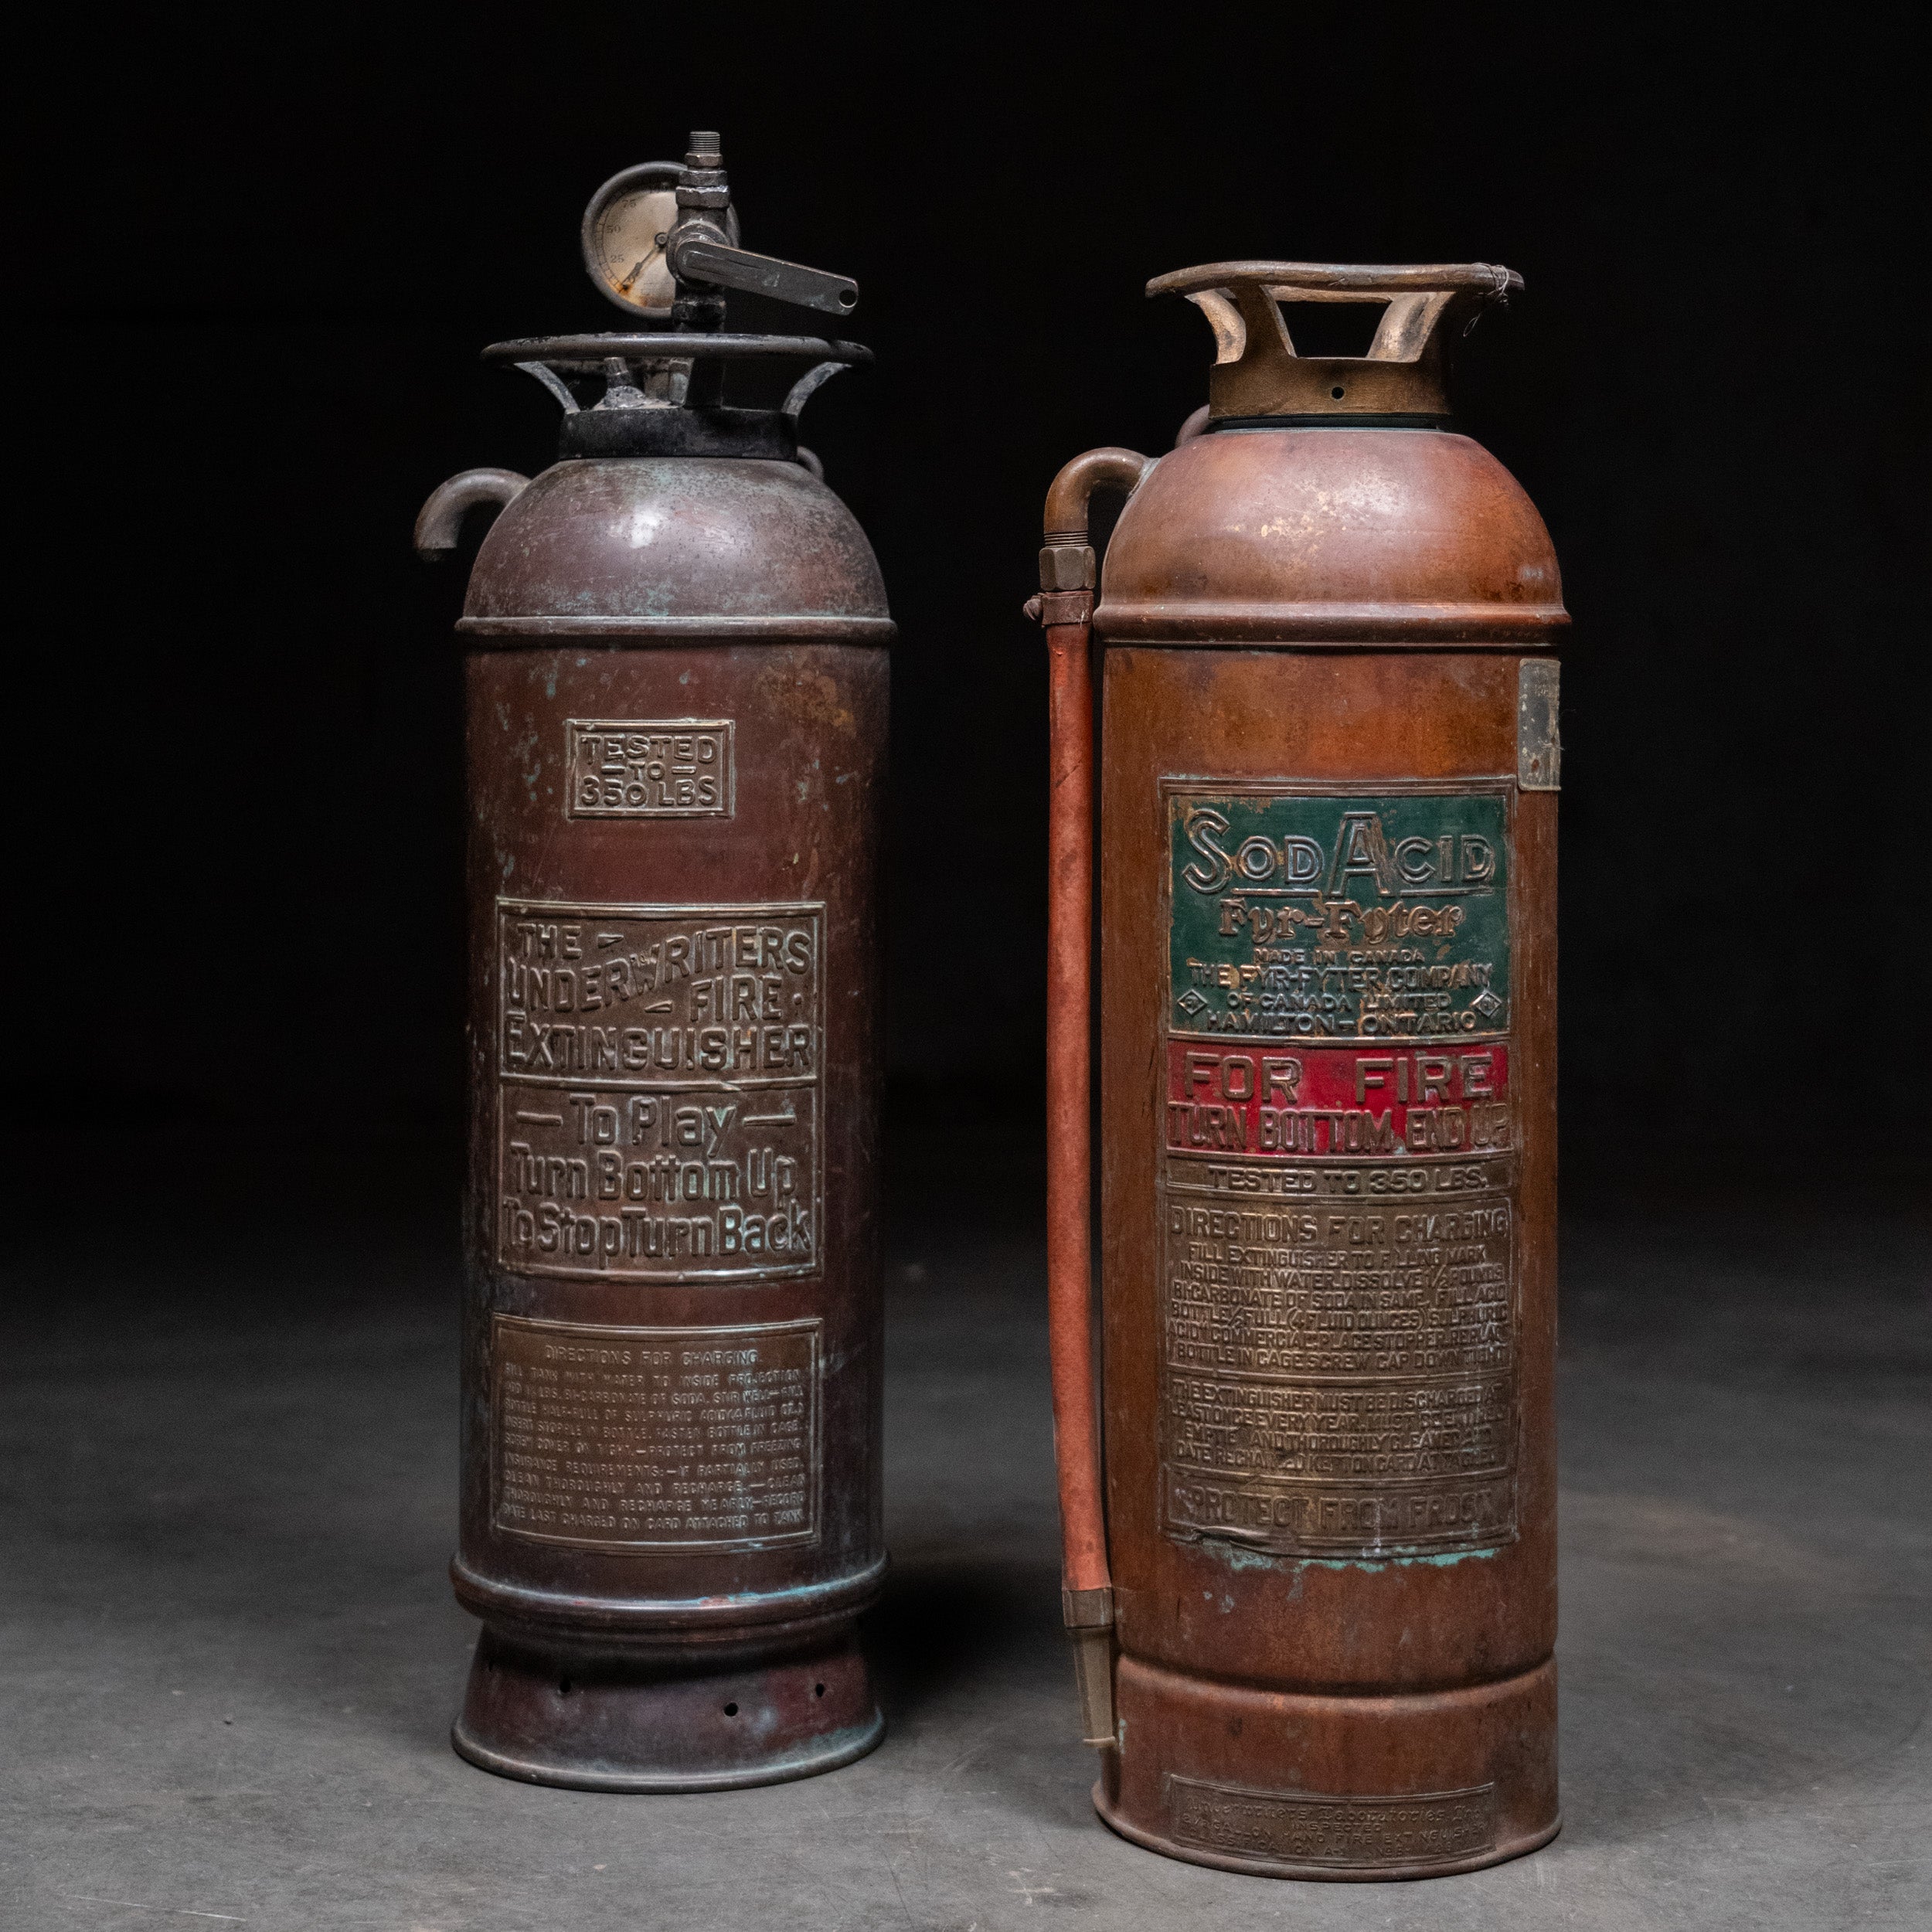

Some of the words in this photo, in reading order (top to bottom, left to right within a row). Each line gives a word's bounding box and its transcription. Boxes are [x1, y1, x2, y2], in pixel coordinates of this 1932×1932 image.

[607, 224, 621, 234] 50
[611, 254, 624, 264] 25
[580, 734, 717, 764] TESTED
[628, 761, 665, 781] TO
[580, 775, 648, 807] 350
[657, 775, 717, 806] LBS
[1218, 896, 1467, 945] Fyr-Fyter
[517, 923, 582, 960] THE
[1253, 947, 1306, 963] MADE
[1312, 949, 1336, 965] IN
[1348, 947, 1425, 965] CANADA
[509, 926, 811, 1012] UNDERWRITERS
[1186, 961, 1232, 988] THE
[1239, 964, 1381, 992] FYR-FYTER
[1387, 961, 1493, 990] COMPANY
[690, 975, 783, 1022] FIRE
[1227, 992, 1255, 1008] OF
[1260, 992, 1352, 1011] CANADA
[1363, 992, 1451, 1011] LIMITED
[1206, 1009, 1335, 1034] HAMILTON
[1362, 1010, 1477, 1035] ONTARIO
[506, 1010, 810, 1071] EXTINGUISHER
[1184, 1050, 1304, 1104] FOR
[1355, 1053, 1493, 1105] FIRE
[570, 1093, 617, 1146] To
[631, 1094, 737, 1158] Play
[1167, 1101, 1246, 1150] TURN
[1258, 1106, 1392, 1152] BOTTOM
[1406, 1106, 1463, 1151] END
[1471, 1103, 1509, 1148] UP
[510, 1141, 589, 1199] Turn
[597, 1150, 740, 1202] Bottom
[747, 1148, 798, 1209] Up
[1207, 1165, 1316, 1194] TESTED
[1324, 1170, 1360, 1195] TO
[1369, 1168, 1424, 1194] 350
[1435, 1167, 1488, 1191] LBS.
[503, 1196, 535, 1250] To
[539, 1202, 622, 1270] Stop
[621, 1206, 716, 1259] Turn
[719, 1200, 811, 1257] Back
[1170, 1206, 1317, 1244] DIRECTIONS
[1329, 1216, 1386, 1245] FOR
[1394, 1207, 1509, 1243] CHARGING
[1189, 1241, 1222, 1262] FILL
[1228, 1246, 1347, 1269] EXTINGUISHER
[1351, 1253, 1373, 1269] TO
[1446, 1243, 1486, 1264] MARK
[1180, 1260, 1230, 1284] INSIDE
[1232, 1266, 1270, 1287] WITH
[1340, 1268, 1422, 1289] DISSOLVE
[1172, 1280, 1281, 1308] BI-CARBONATE
[1286, 1290, 1308, 1308] OF
[1311, 1291, 1356, 1309] SODA
[1361, 1291, 1375, 1309] IN
[1436, 1285, 1472, 1306] FILL
[1474, 1282, 1505, 1303] ACID
[1172, 1298, 1229, 1323] BOTTLE
[1243, 1307, 1286, 1328] FULL
[1305, 1311, 1354, 1330] FLUID
[1429, 1302, 1507, 1327] SULPHURIC
[546, 1345, 631, 1366] DIRECTIONS
[641, 1350, 671, 1366] FOR
[1175, 1340, 1235, 1364] BOTTLE
[1238, 1347, 1252, 1366] IN
[1256, 1349, 1303, 1368] CAGE
[1307, 1352, 1369, 1369] SCREW
[1376, 1350, 1409, 1369] CAP
[1413, 1346, 1459, 1367] DOWN
[1318, 1332, 1371, 1350] PLACE
[530, 1365, 558, 1380] TANK
[603, 1372, 643, 1386] WATER
[652, 1375, 670, 1387] TO
[680, 1374, 719, 1386] INSIDE
[539, 1385, 562, 1399] LBS.
[563, 1388, 646, 1404] BI-CARBONATE
[650, 1393, 666, 1404] OF
[672, 1392, 709, 1404] SODA.
[713, 1390, 739, 1403] STIR
[1172, 1376, 1200, 1399] THE
[1203, 1382, 1314, 1410] EXTINGUISHER
[1316, 1393, 1362, 1412] MUST
[1365, 1394, 1386, 1412] BE
[1389, 1386, 1481, 1411] DISCHARGED
[605, 1408, 617, 1420] OF
[624, 1409, 692, 1422] SULPHURIC
[1172, 1399, 1211, 1422] LEAST
[1214, 1405, 1253, 1427] ONCE
[1255, 1409, 1310, 1430] EVERY
[1313, 1412, 1366, 1430] YEAR.
[1367, 1411, 1415, 1430] MUST
[707, 1424, 750, 1439] BOTTLE
[1250, 1428, 1285, 1448] AND
[1286, 1431, 1386, 1451] THOROUGHLY
[574, 1440, 589, 1454] ON
[711, 1442, 746, 1456] FROM
[1177, 1438, 1210, 1461] DATE
[1352, 1455, 1372, 1472] ON
[504, 1451, 556, 1471] INSURANCE
[697, 1461, 764, 1477] PARTIALLY
[505, 1469, 539, 1486] CLEAN
[546, 1475, 624, 1494] THOROUGHLY
[634, 1482, 662, 1495] AND
[504, 1485, 572, 1507] THOROUGHLY
[582, 1496, 608, 1510] AND
[618, 1498, 692, 1512] RECHARGE
[1189, 1485, 1309, 1528] PROTECT
[1319, 1496, 1398, 1529] FROM
[502, 1503, 525, 1519] DATE
[529, 1507, 556, 1523] LAST
[562, 1512, 615, 1529] CHARGED
[621, 1516, 640, 1529] ON
[645, 1518, 680, 1530] CARD
[685, 1515, 748, 1530] ATTACHED
[753, 1512, 769, 1526] TO
[1291, 1819, 1382, 1834] INSPECTED
[1335, 1833, 1372, 1845] FIRE
